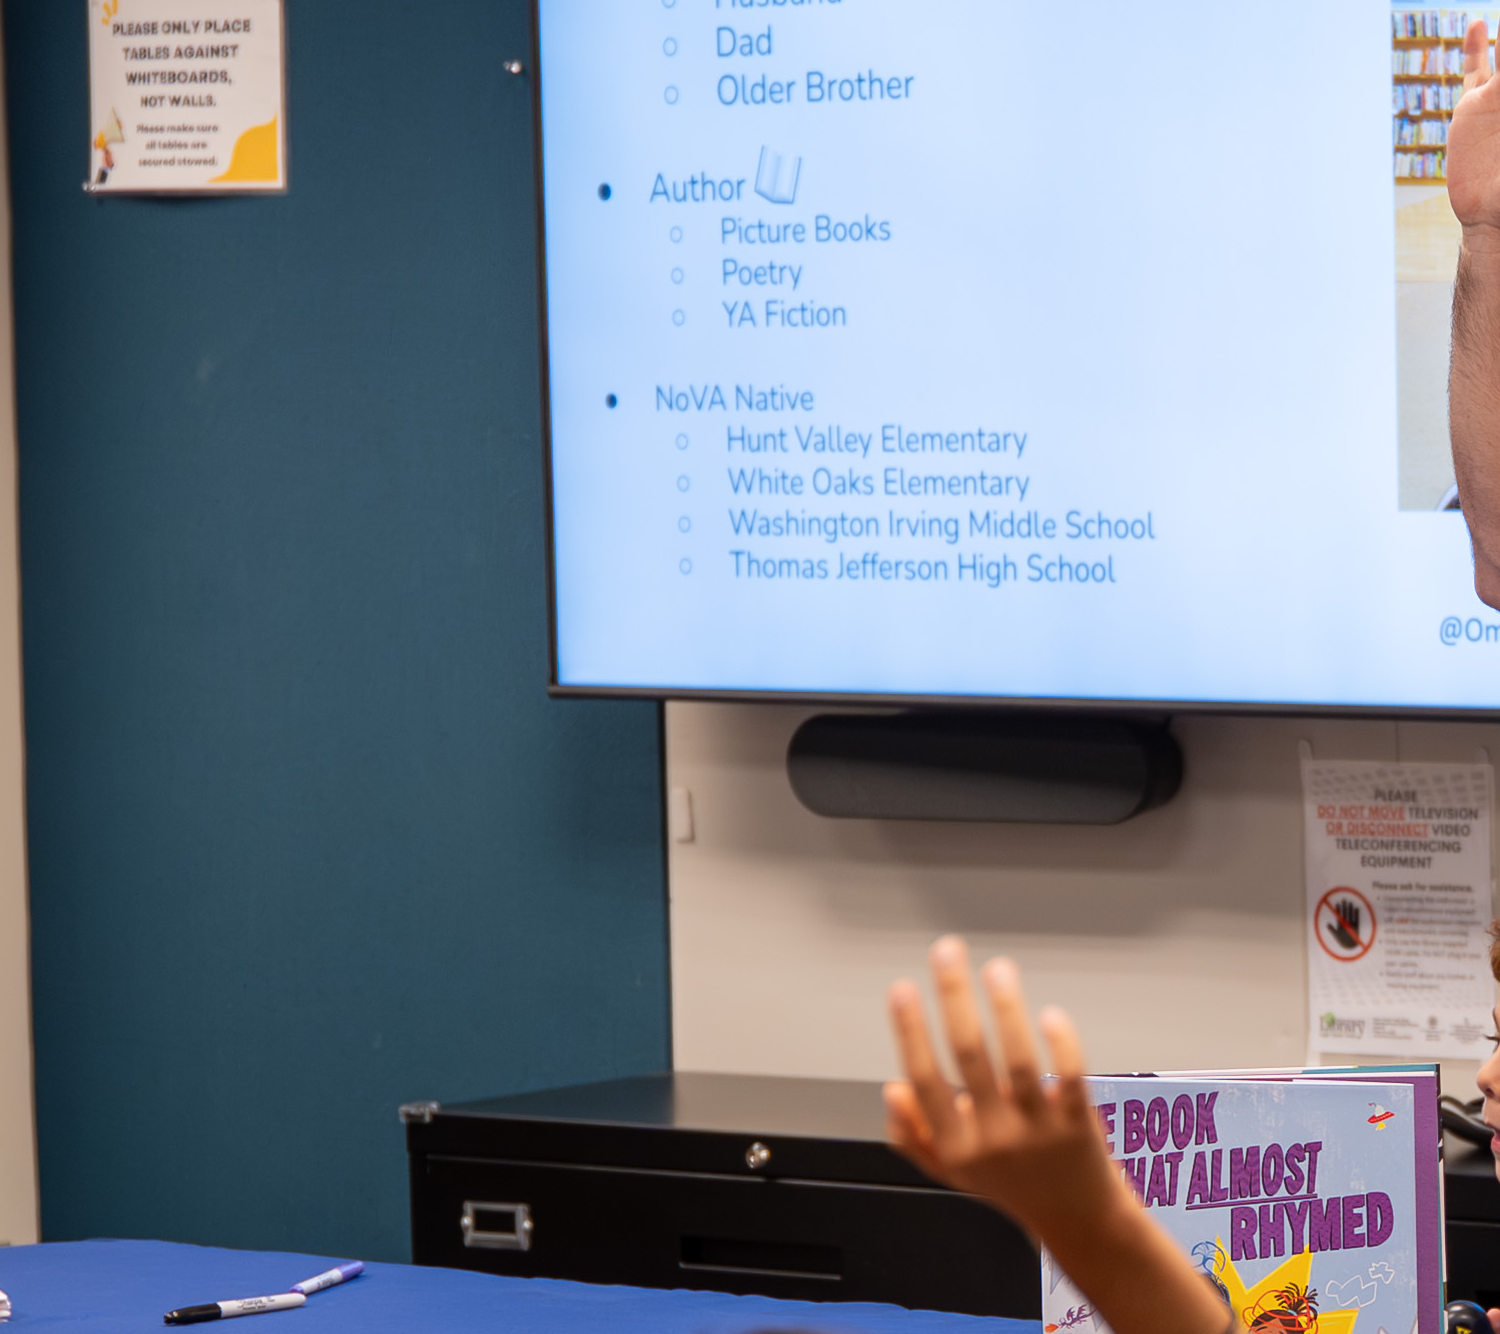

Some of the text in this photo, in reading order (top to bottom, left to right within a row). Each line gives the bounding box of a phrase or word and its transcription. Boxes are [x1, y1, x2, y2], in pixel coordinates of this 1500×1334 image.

[113, 19, 251, 36] PLEASE ONLY PLACE
[716, 26, 772, 58] Dad
[123, 45, 239, 60] TABLES AGAINST
[125, 71, 233, 85] WHITEBOARDS,
[717, 70, 915, 106] Older Brother
[140, 95, 165, 108] NOT
[649, 171, 746, 204] Author
[721, 214, 891, 246] Picture Books
[722, 258, 803, 291] Poetry
[723, 299, 847, 328] YA Fiction
[655, 383, 814, 412] NoVA Native
[726, 425, 1028, 461] Hunt Valley Elementary
[729, 468, 1030, 502] White Oaks Elementary
[729, 510, 1155, 544] Washington Irving Middle School
[730, 550, 1117, 589] Thomas Jefferson High School
[1374, 789, 1417, 802] PLEASE
[1318, 805, 1479, 820] DO NOT MOVE TELEVISION
[1335, 838, 1462, 853] TELECONFERENCING
[1347, 822, 1428, 837] DISCONNECT
[1432, 824, 1471, 837] VIDEO
[1360, 854, 1433, 868] EQUIPMENT
[1124, 1091, 1219, 1154] BOOK
[1186, 1141, 1323, 1206] ALMOST
[1230, 1192, 1395, 1262] RHYMED
